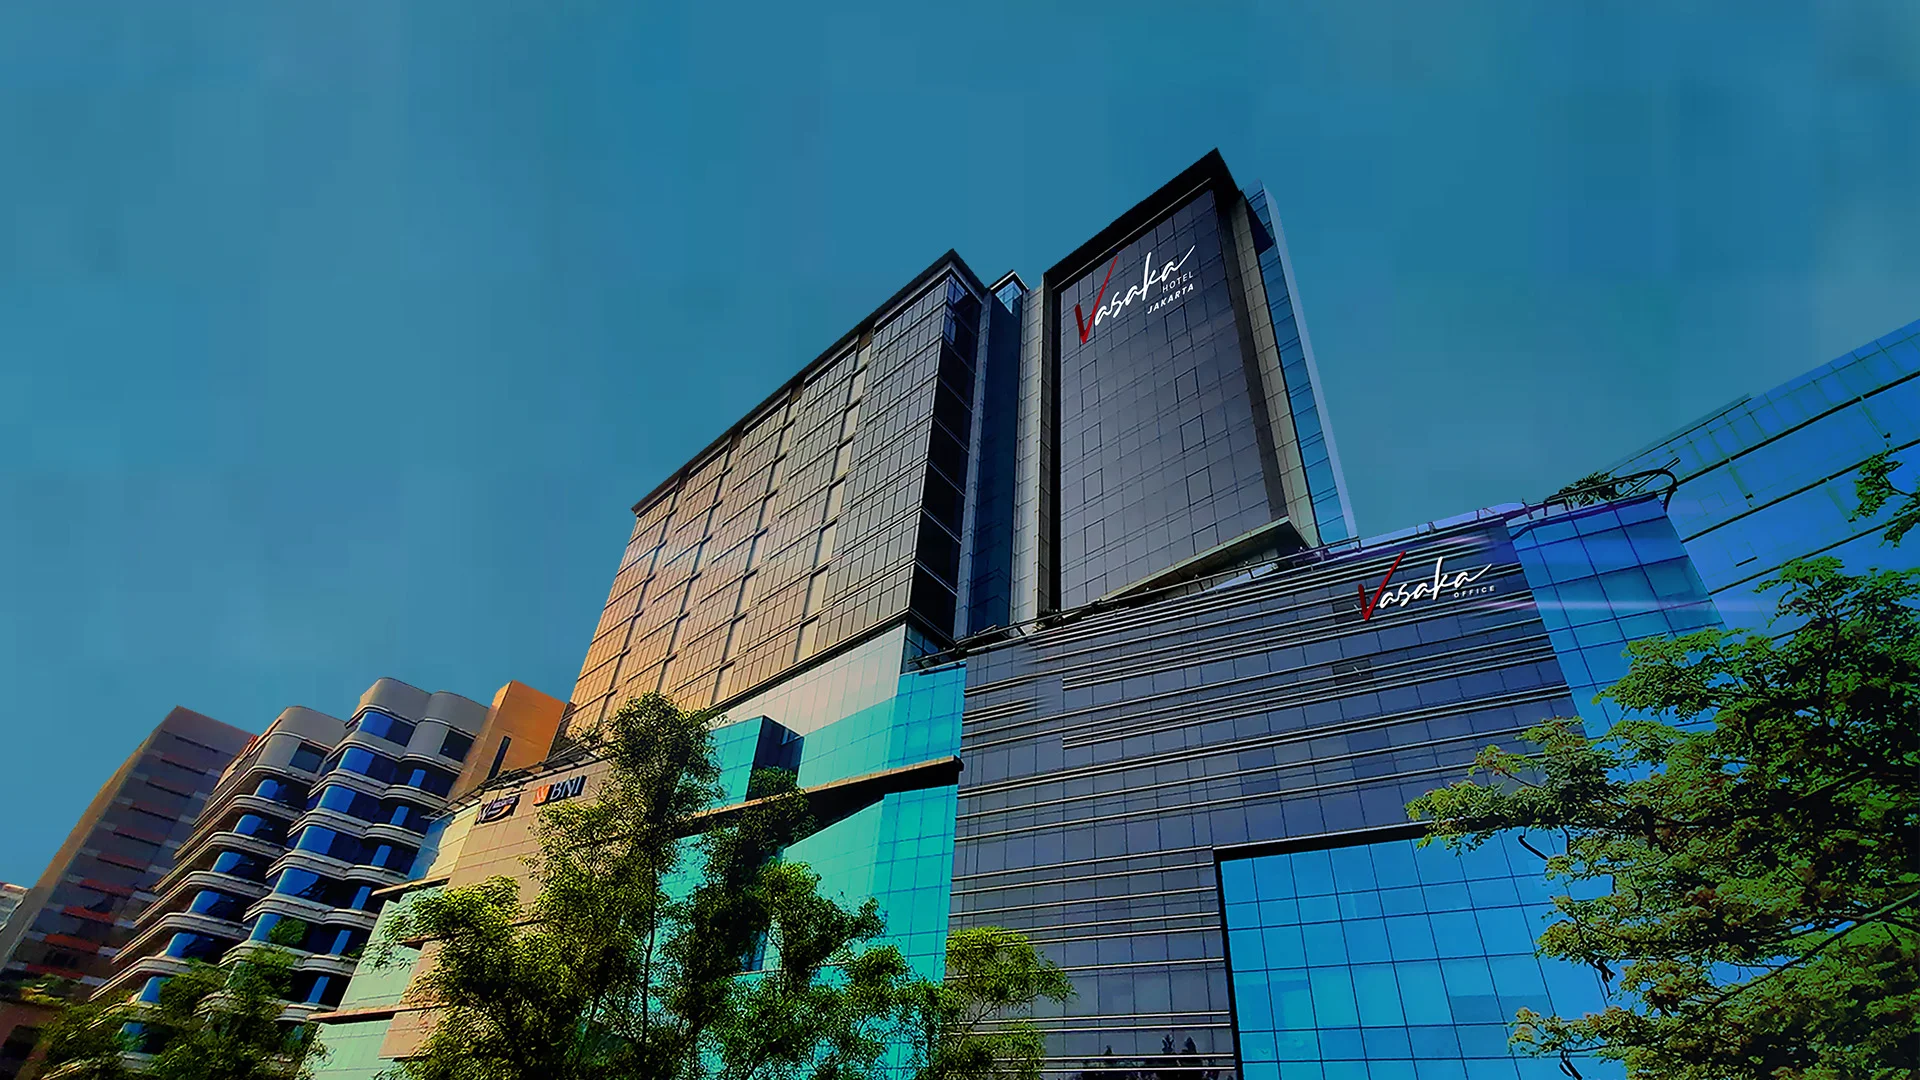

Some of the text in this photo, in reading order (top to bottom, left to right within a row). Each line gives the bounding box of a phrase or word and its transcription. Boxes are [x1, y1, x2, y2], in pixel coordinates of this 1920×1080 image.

[1074, 245, 1195, 344] Vasaka
[1162, 271, 1194, 293] HOTEL
[1147, 283, 1194, 314] JAKARTA
[1358, 550, 1492, 621] Vasaka
[1453, 585, 1495, 598] OFFICE
[551, 776, 583, 800] BNI
